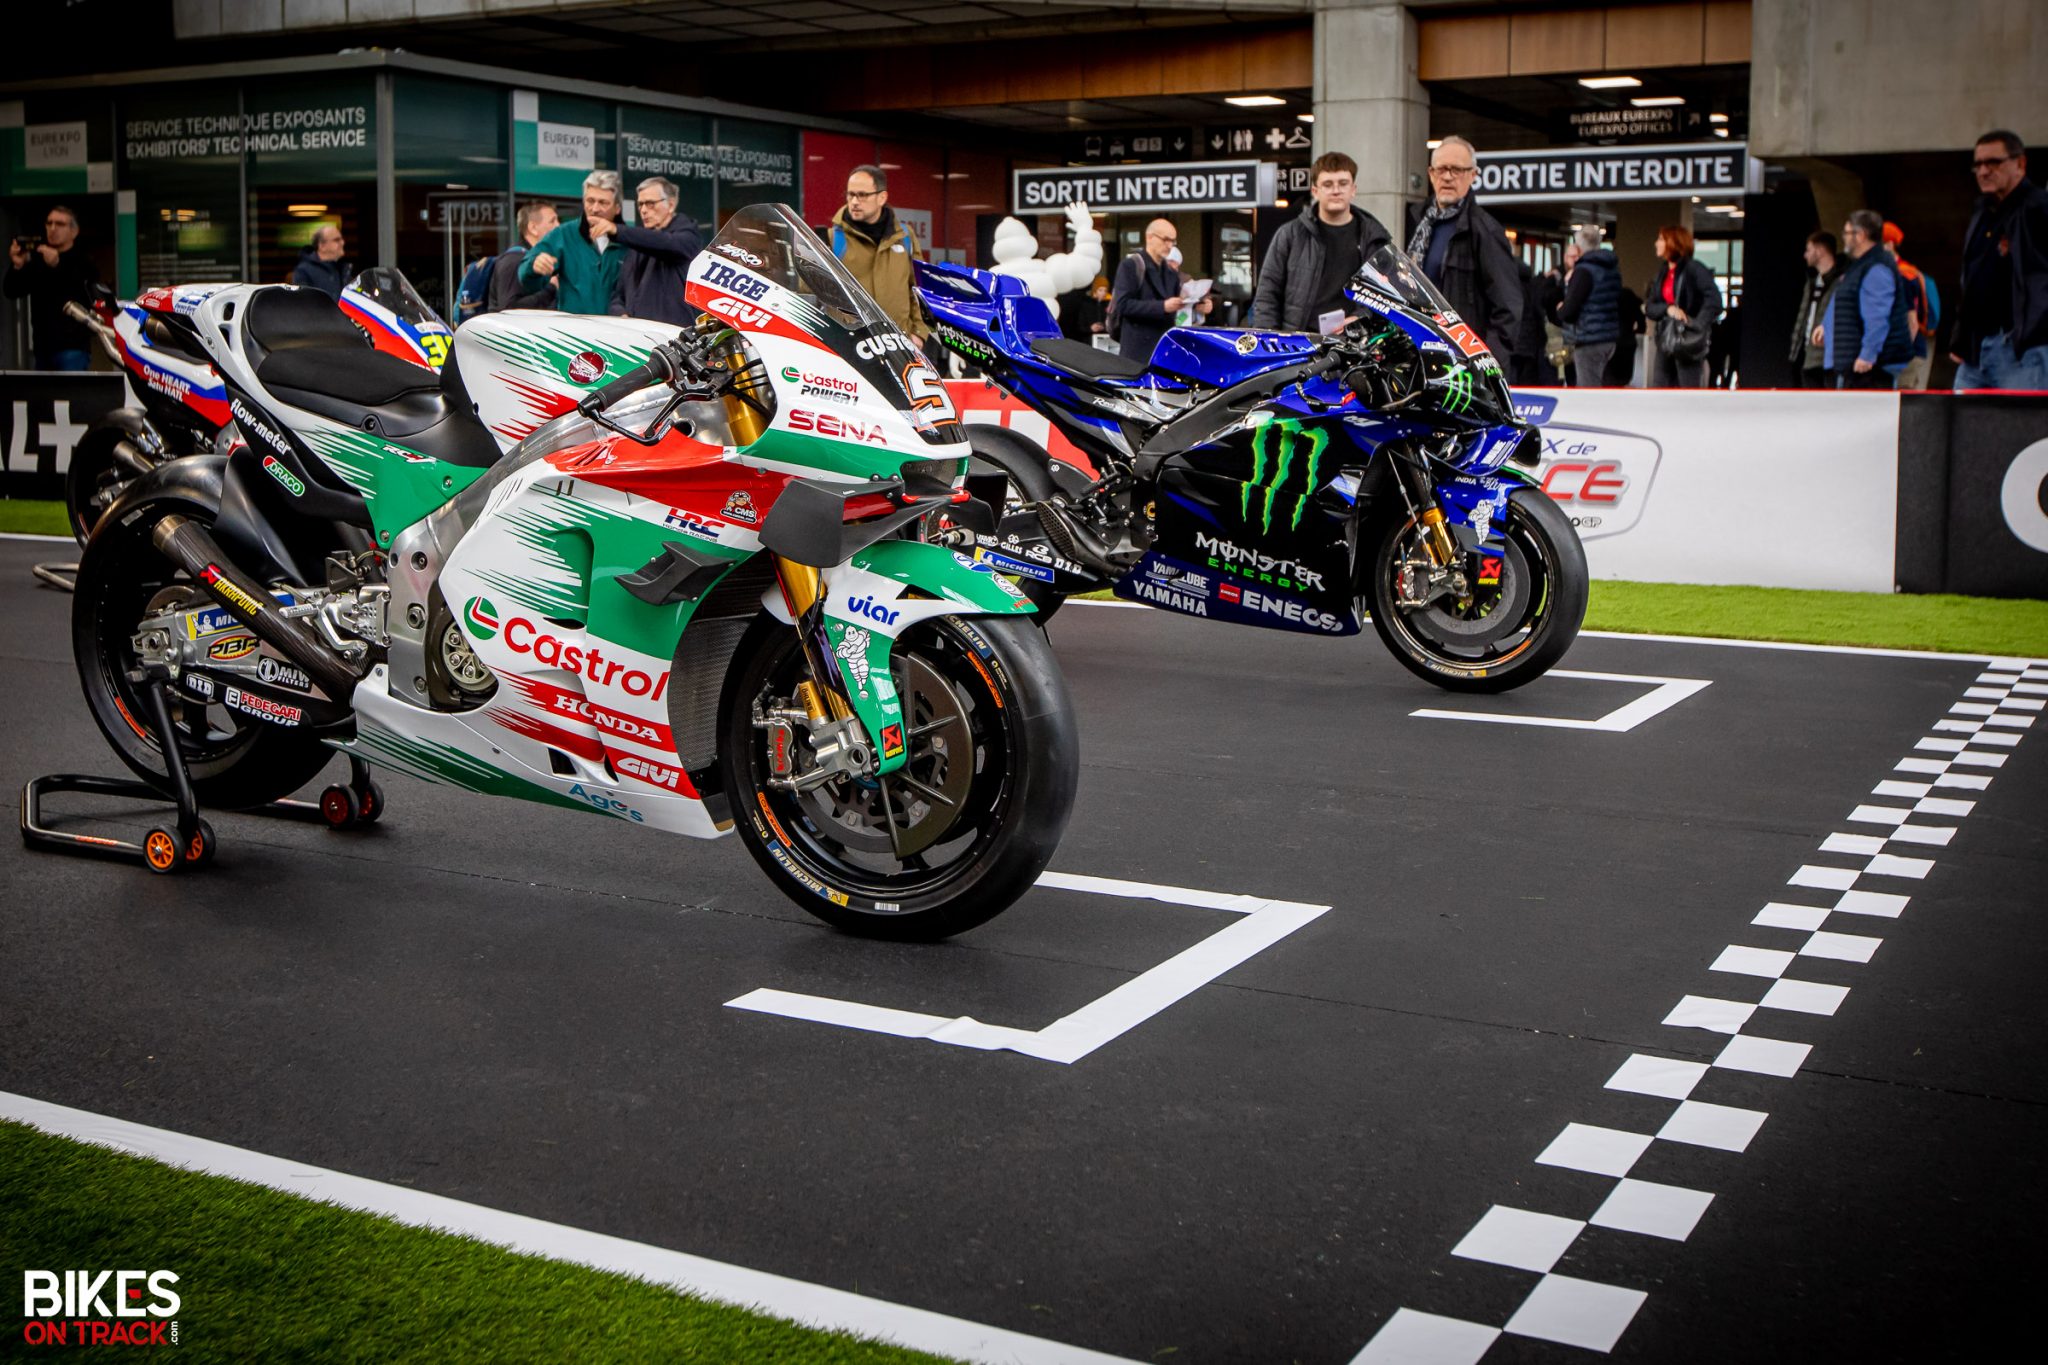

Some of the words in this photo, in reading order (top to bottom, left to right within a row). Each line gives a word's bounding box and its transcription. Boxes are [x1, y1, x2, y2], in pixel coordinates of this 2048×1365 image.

[126, 118, 183, 140] SERVICE
[186, 112, 270, 136] TECHNIQUE
[273, 106, 366, 130] EXPOSANTS
[1569, 110, 1620, 126] BUREAUX
[1622, 107, 1674, 123] EUREXPO
[1577, 122, 1627, 138] EUREXPO
[1628, 120, 1673, 136] OFFICES
[30, 130, 81, 146] EUREXPO
[43, 144, 69, 159] LYON
[126, 137, 210, 160] EXHIBITORS'
[212, 133, 299, 155] TECHNICAL
[301, 128, 366, 150] SERVICE
[543, 130, 590, 148] EUREXPO
[555, 145, 579, 161] LYON
[627, 136, 673, 158] SERVICE
[734, 147, 792, 170] EXPOSANTS
[627, 155, 692, 178] EXHIBITORS'
[752, 167, 792, 188] SERVICE
[1470, 161, 1567, 191] SORTIE
[1574, 155, 1733, 188] INTERDITE
[1025, 177, 1110, 205] SORTIE
[1116, 172, 1248, 201] INTERDITE
[700, 261, 770, 302] IRGE
[707, 296, 774, 329] GIVI
[1351, 291, 1391, 315] YAMAHA
[937, 320, 998, 359] MONSTER
[944, 335, 989, 361] ENERGY
[802, 373, 858, 394] Castrol
[229, 398, 292, 456] flow-meter
[787, 408, 888, 446] SENA
[1566, 441, 1598, 455] de
[268, 462, 302, 493] DRACO
[1454, 475, 1477, 486] INDIA
[664, 507, 726, 538] HRC
[1000, 541, 1023, 555] GILLES
[1025, 549, 1053, 564] RCB
[1195, 531, 1326, 592] MONSTER
[995, 560, 1047, 577] MICHELIN
[1153, 560, 1210, 589] YAMUBE
[1207, 556, 1309, 592] ENERGY
[847, 594, 901, 627] viar
[1133, 579, 1208, 617] YAMAHA
[1242, 589, 1344, 632] ENEOS
[503, 616, 672, 702] Castrol
[277, 675, 309, 689] FILTERS
[239, 704, 300, 728] GROUP
[240, 692, 302, 721] FEDEGARI
[615, 756, 681, 789] GIVI
[772, 848, 823, 892] MICHELIN
